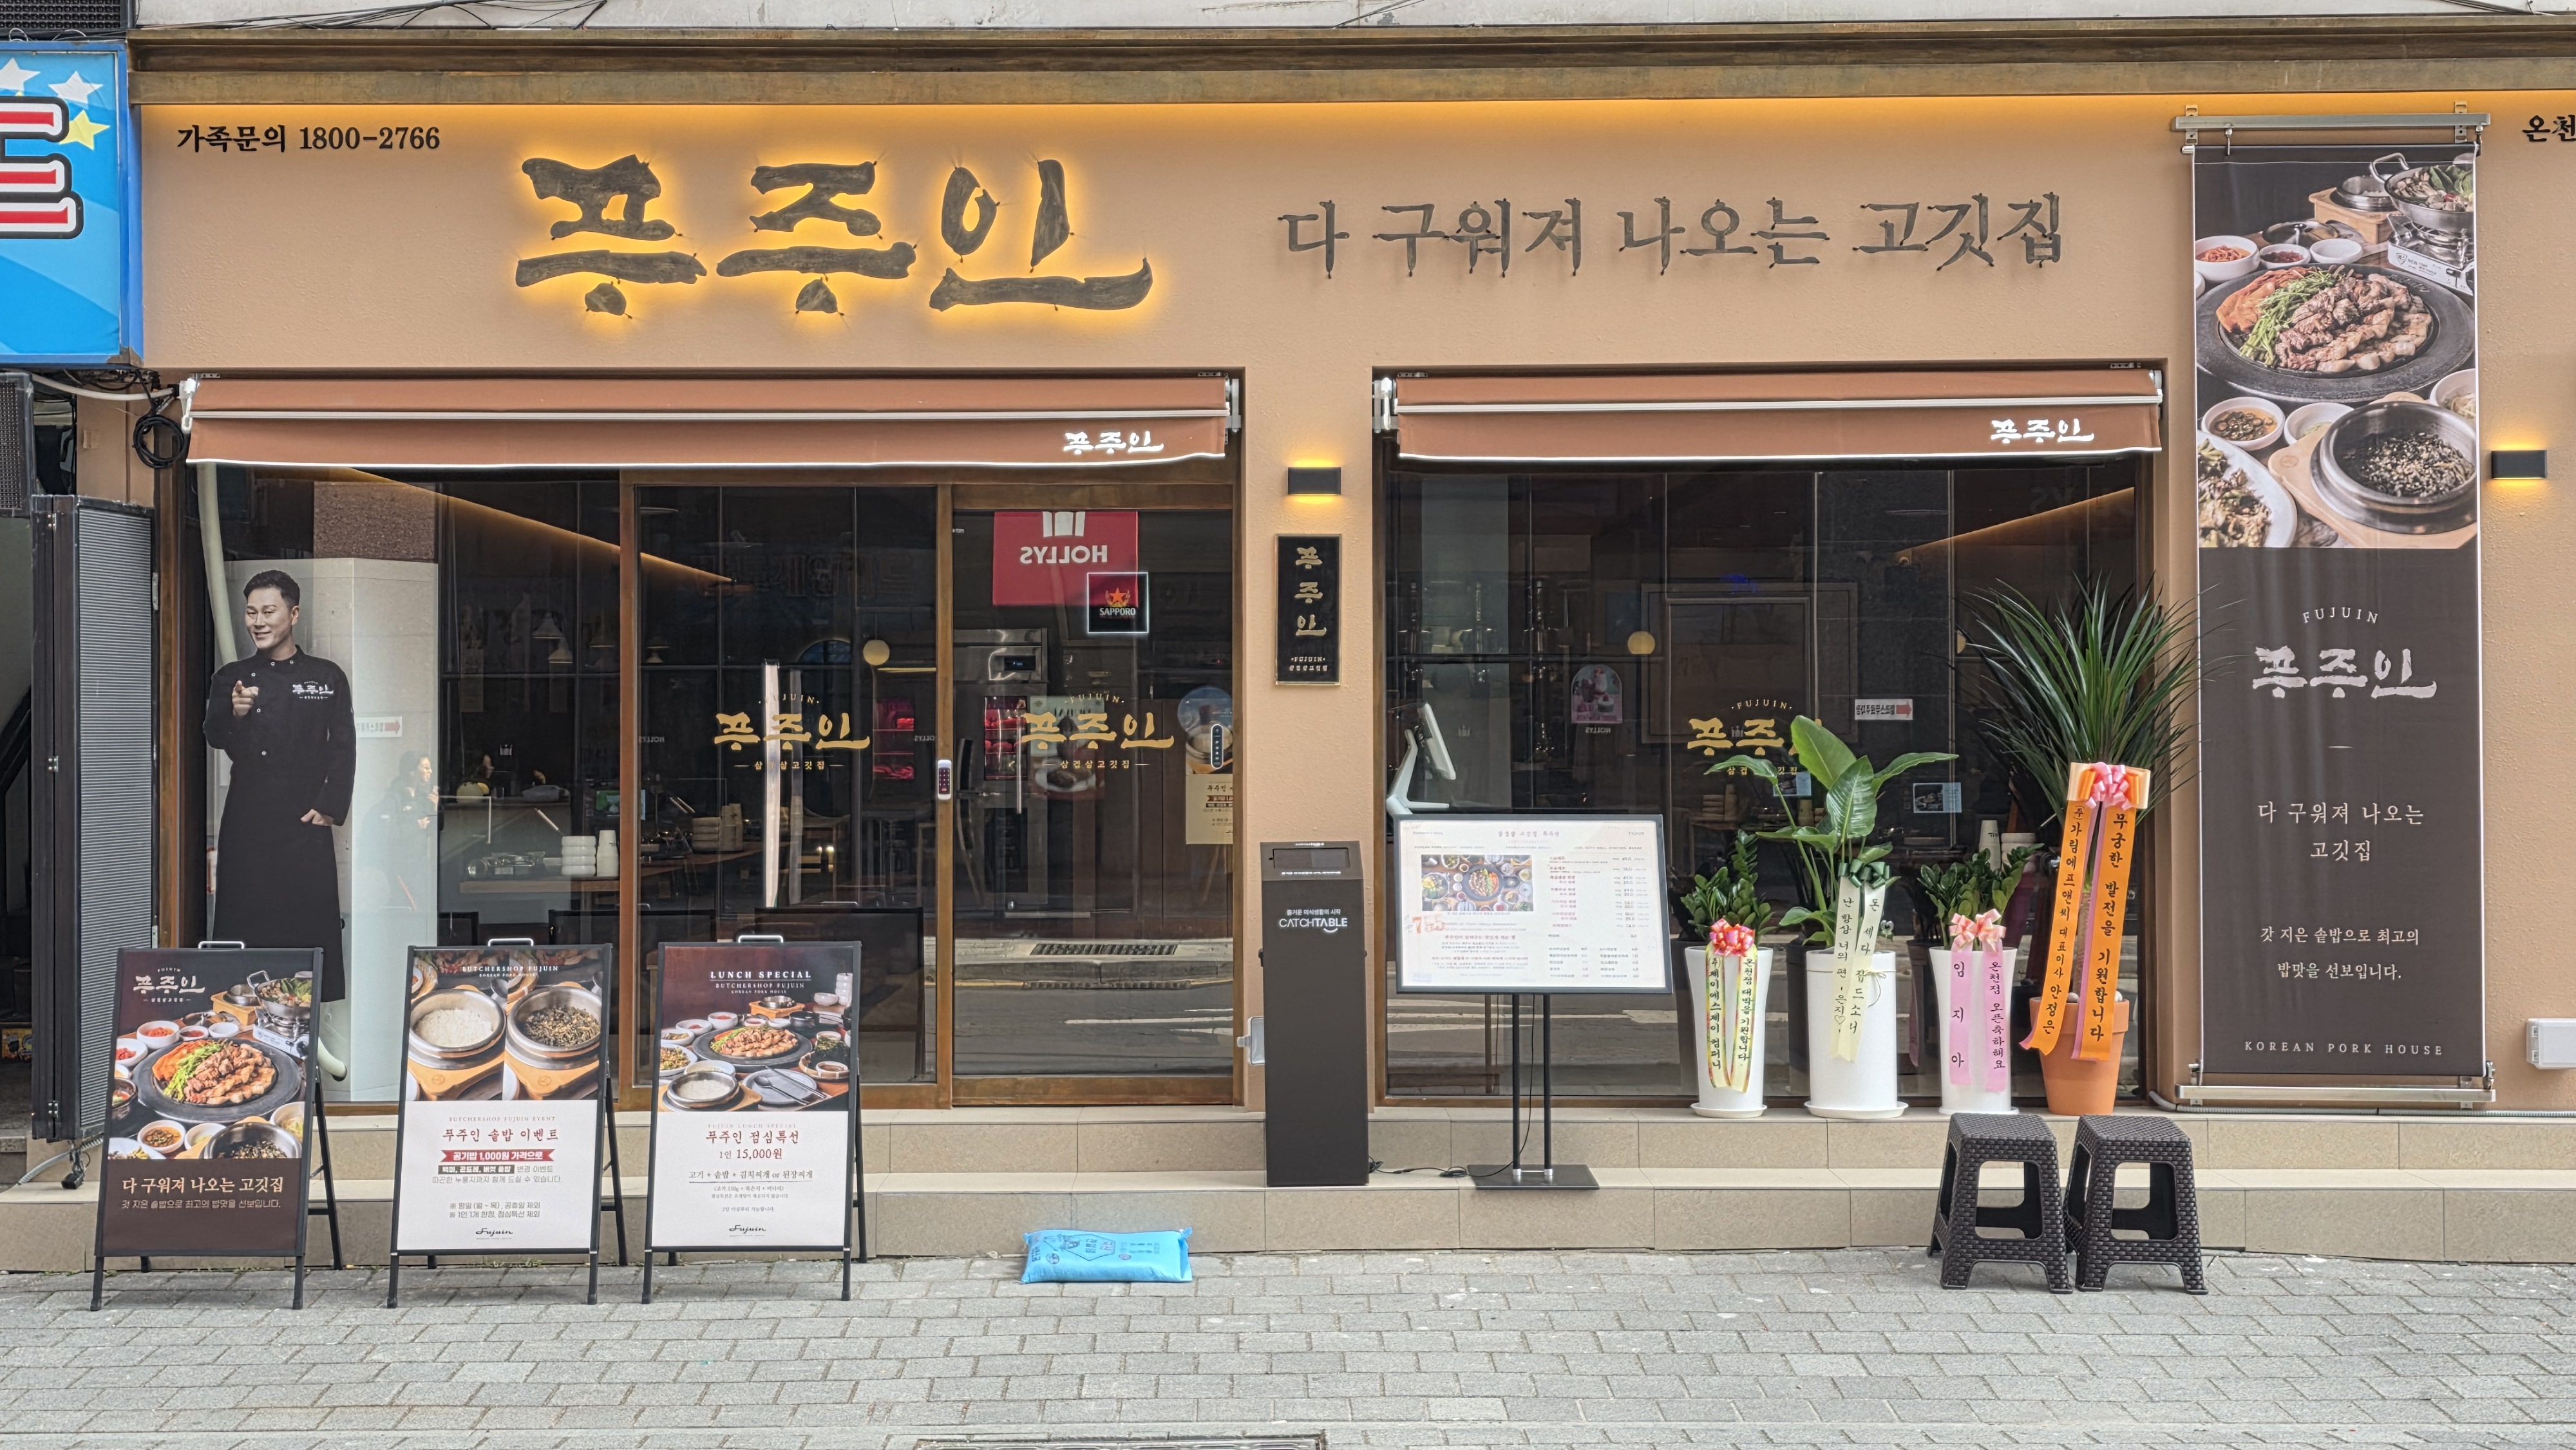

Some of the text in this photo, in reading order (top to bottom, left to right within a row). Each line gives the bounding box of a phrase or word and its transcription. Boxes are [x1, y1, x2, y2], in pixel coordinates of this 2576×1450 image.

[176, 124, 440, 153] 가족문의 1800-2766
[2522, 115, 2576, 142] 온천
[515, 154, 1153, 316] 푸주인
[1278, 192, 2062, 278] 다 구워져 나오는 고깃집
[1063, 431, 1164, 454] 푸주인
[1990, 419, 2095, 444] 푸주인
[1294, 546, 1327, 637] 푸주인
[1099, 607, 1136, 616] SAPPORO
[2302, 607, 2380, 625] FUJUIN
[2253, 646, 2437, 699] 푸주인
[1069, 693, 1121, 704] FUJUIN
[1737, 699, 1787, 709] FUJUIN
[714, 712, 870, 751] 푸주인
[1021, 711, 1175, 749] 푸주인
[1687, 717, 1822, 755] 푸주
[2258, 802, 2424, 825] 다 구워져 나오는
[2310, 840, 2372, 862] 고깃집
[1279, 918, 1348, 928] CATCHTABLE
[2090, 813, 2128, 1042] 무궁한 발전을 기원합니다
[2260, 927, 2420, 945] 갓 지은 솥밥으로 최고의
[2054, 927, 2069, 979] 대표이사
[1743, 958, 1755, 985] 온천점
[1989, 961, 2002, 995] 온천점
[2277, 962, 2402, 981] 밥맛을 선보입니다.
[133, 975, 205, 994] 푸주인
[1741, 988, 1754, 1015] 대박을
[2043, 984, 2062, 1035] 안정은
[2244, 1040, 2443, 1056] KOREAN PORK HOUSE
[442, 1128, 480, 1142] 푸주인
[520, 1128, 558, 1142] 이벤트
[706, 1131, 799, 1144] 푸주인 점심특선
[479, 1151, 509, 1161] 1,000원
[511, 1151, 543, 1160] 가격으로
[719, 1148, 782, 1160] 1인 15,000원
[122, 1176, 283, 1194] 다 구워져 나오는 고깃집
[688, 1170, 704, 1179] 고기
[739, 1170, 770, 1179] 김치찌개
[782, 1170, 813, 1179] 된장찌개
[475, 1227, 514, 1237] Fujuin
[728, 1225, 766, 1234] Fujuin
